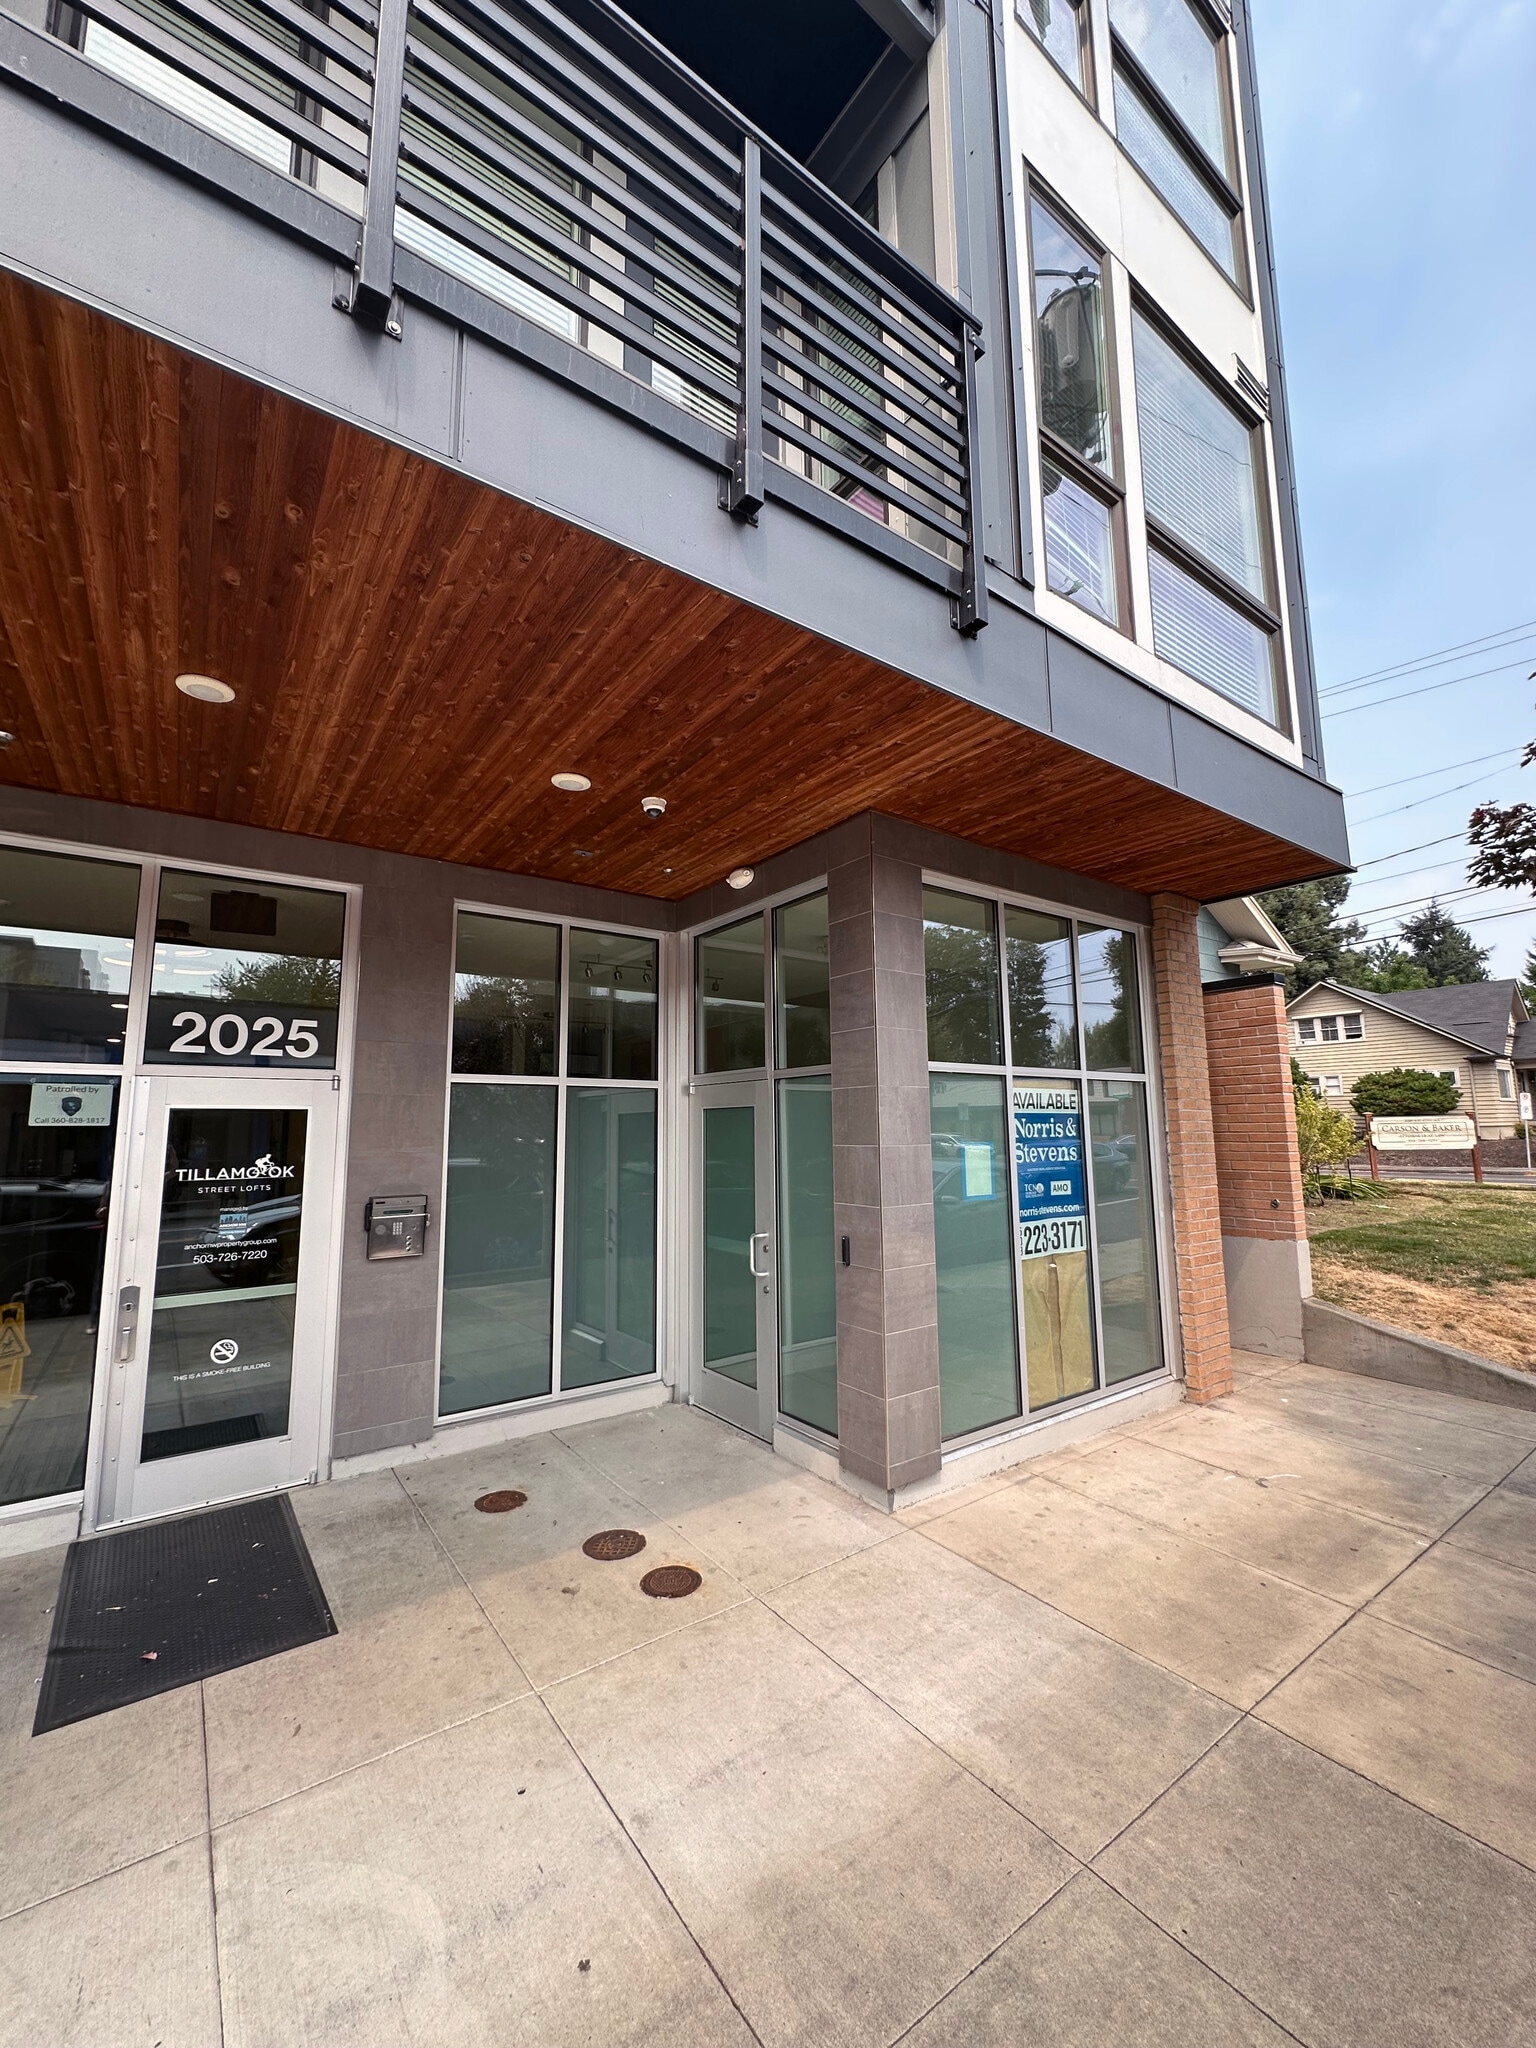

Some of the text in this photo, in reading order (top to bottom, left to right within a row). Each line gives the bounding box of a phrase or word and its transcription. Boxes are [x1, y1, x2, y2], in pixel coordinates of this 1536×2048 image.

[169, 1011, 319, 1059] 2025
[46, 1085, 100, 1094] Patrolled by
[1013, 1091, 1076, 1110] AVAILABLE
[1015, 1117, 1077, 1138] Norris &
[1381, 1123, 1463, 1133] CARSON & BAKER
[1016, 1142, 1078, 1163] Stevens
[175, 1165, 295, 1181] TILLAMOOK
[197, 1184, 272, 1194] STREET LOFTS
[1052, 1183, 1069, 1193] AMO
[193, 1249, 268, 1264] 503-726-7220
[173, 1374, 188, 1382] THIS
[202, 1366, 242, 1378] SMOKE-FREE
[243, 1361, 271, 1372] BUILDING
